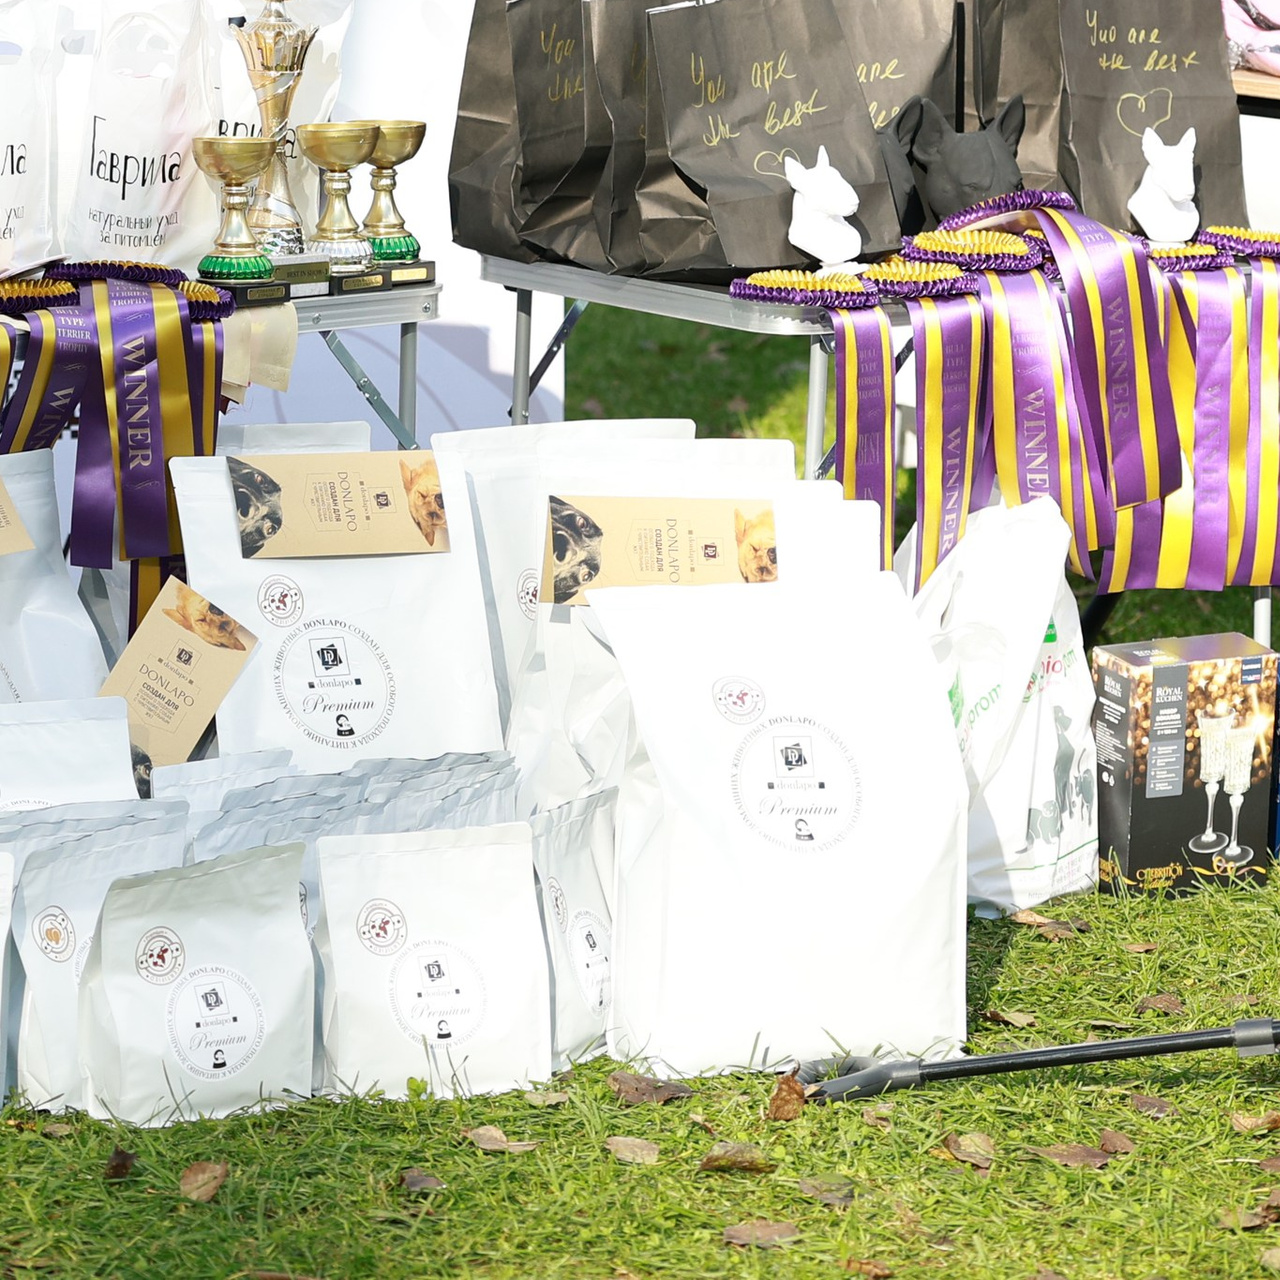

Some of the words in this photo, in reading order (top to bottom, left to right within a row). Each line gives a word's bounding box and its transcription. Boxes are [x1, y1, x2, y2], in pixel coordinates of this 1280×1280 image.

[90, 115, 183, 200] Гаврила
[88, 207, 152, 228] натуральный
[99, 231, 112, 244] за
[115, 232, 166, 247] питомцем
[111, 297, 147, 306] TROPHY
[58, 316, 86, 327] TYPE
[56, 328, 92, 340] TERRIER
[57, 342, 88, 354] TROPHY
[1105, 296, 1131, 422] WINNER
[121, 335, 154, 470] WINNER
[328, 481, 338, 507] СОЗДАН
[942, 426, 963, 553] WINNER
[337, 470, 357, 532] DONLAPO
[332, 507, 341, 522] ДЛЯ
[654, 528, 662, 555] СОЗДАН
[665, 518, 680, 583] DONLAPO
[303, 619, 347, 631] DONLAPO
[348, 624, 380, 653] СОЗДАН
[273, 626, 304, 673] ЖИВОТНЫХ
[376, 651, 391, 671] ДЛЯ
[138, 662, 196, 708] DONLAPO
[317, 679, 353, 688] donlapo
[141, 681, 166, 701] СОЗДАН
[164, 698, 179, 711] ДЛЯ
[273, 674, 304, 730] ДОМАШНИХ
[302, 693, 375, 714] Premium
[387, 672, 397, 717] ОСОБОГО
[358, 715, 391, 748] ПОДХОДА
[769, 715, 816, 727] DONLAPO
[303, 728, 349, 749] ПИТАНИЮ
[776, 780, 816, 792] donlapo
[759, 796, 838, 815] Premium
[189, 967, 225, 978] DONLAPO
[411, 1003, 470, 1019] Premium
[202, 1017, 231, 1028] donlapo
[189, 1031, 247, 1051] Premium
